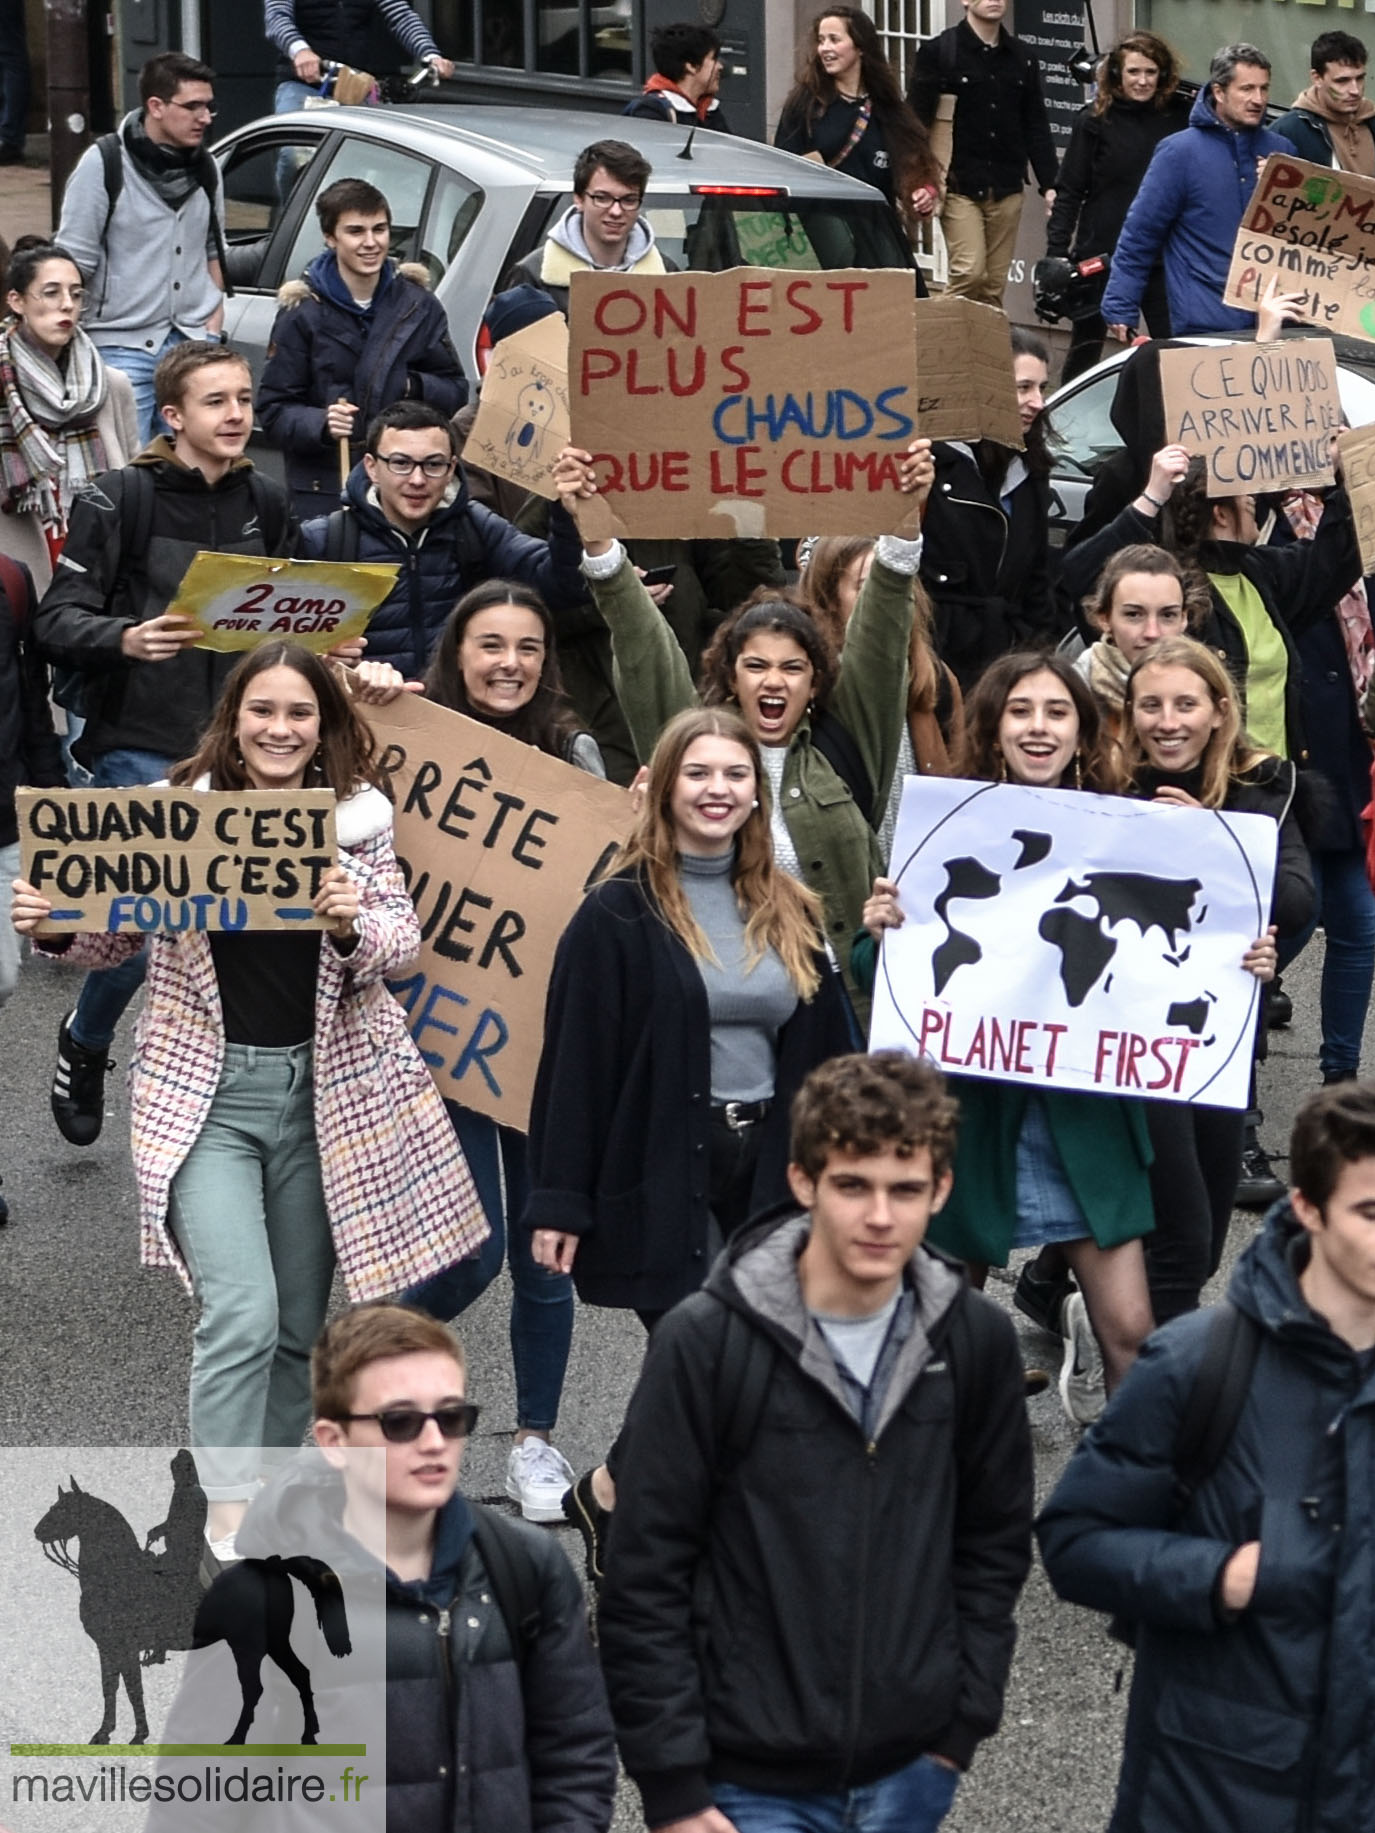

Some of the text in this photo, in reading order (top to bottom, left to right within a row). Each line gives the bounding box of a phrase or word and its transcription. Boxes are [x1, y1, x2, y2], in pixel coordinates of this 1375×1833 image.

[594, 280, 870, 339] ON EST
[580, 345, 752, 397] PLUS
[1190, 357, 1244, 400] CE
[711, 386, 915, 445] CHAUDS
[1178, 403, 1298, 442] ARRIVER
[589, 450, 690, 495] QUE
[709, 446, 769, 498] LE
[232, 583, 347, 615] 2 ans
[268, 614, 341, 634] AGIR
[29, 798, 331, 849] QUAND C'EST
[377, 742, 560, 870] RRÊTE
[29, 849, 333, 899] FONDU C'EST
[108, 894, 249, 933] FOUTU
[918, 1007, 1201, 1094] PLANET FIRST
